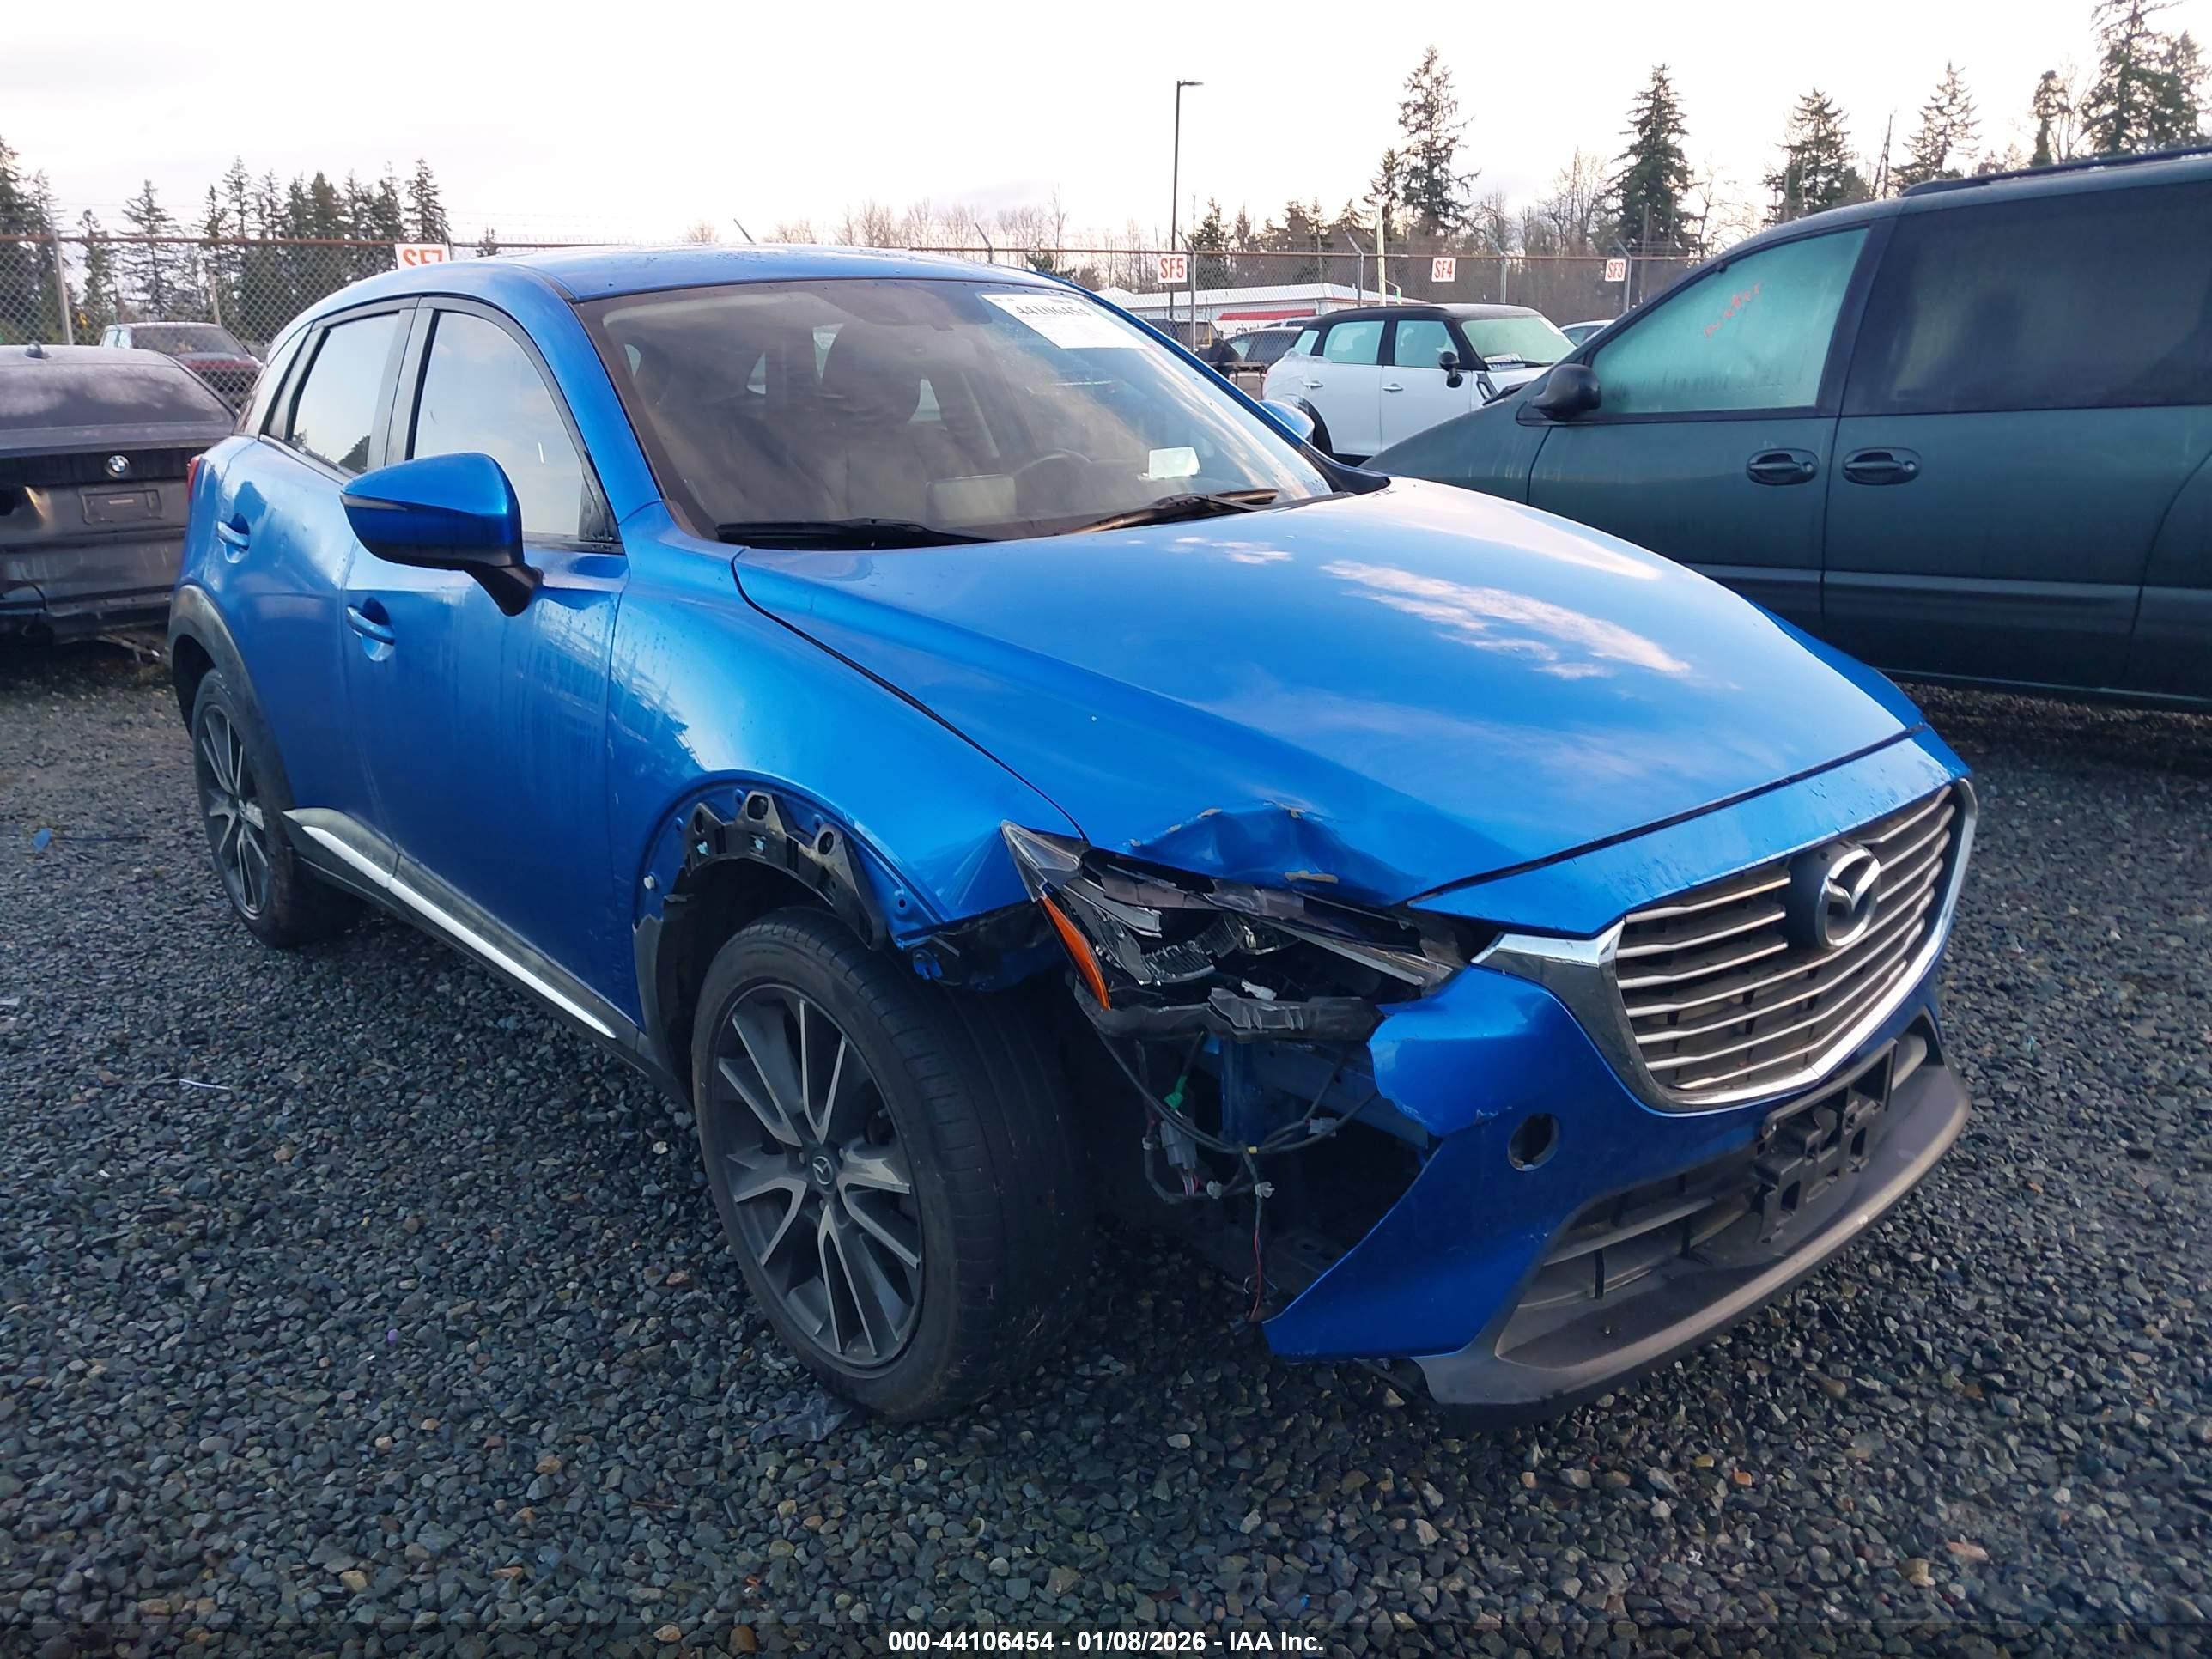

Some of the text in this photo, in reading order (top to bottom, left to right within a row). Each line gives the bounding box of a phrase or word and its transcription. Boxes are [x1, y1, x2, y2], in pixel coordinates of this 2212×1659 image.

[1160, 258, 1184, 279] SF5
[1434, 260, 1453, 278] SF4
[1607, 262, 1625, 278] SF3
